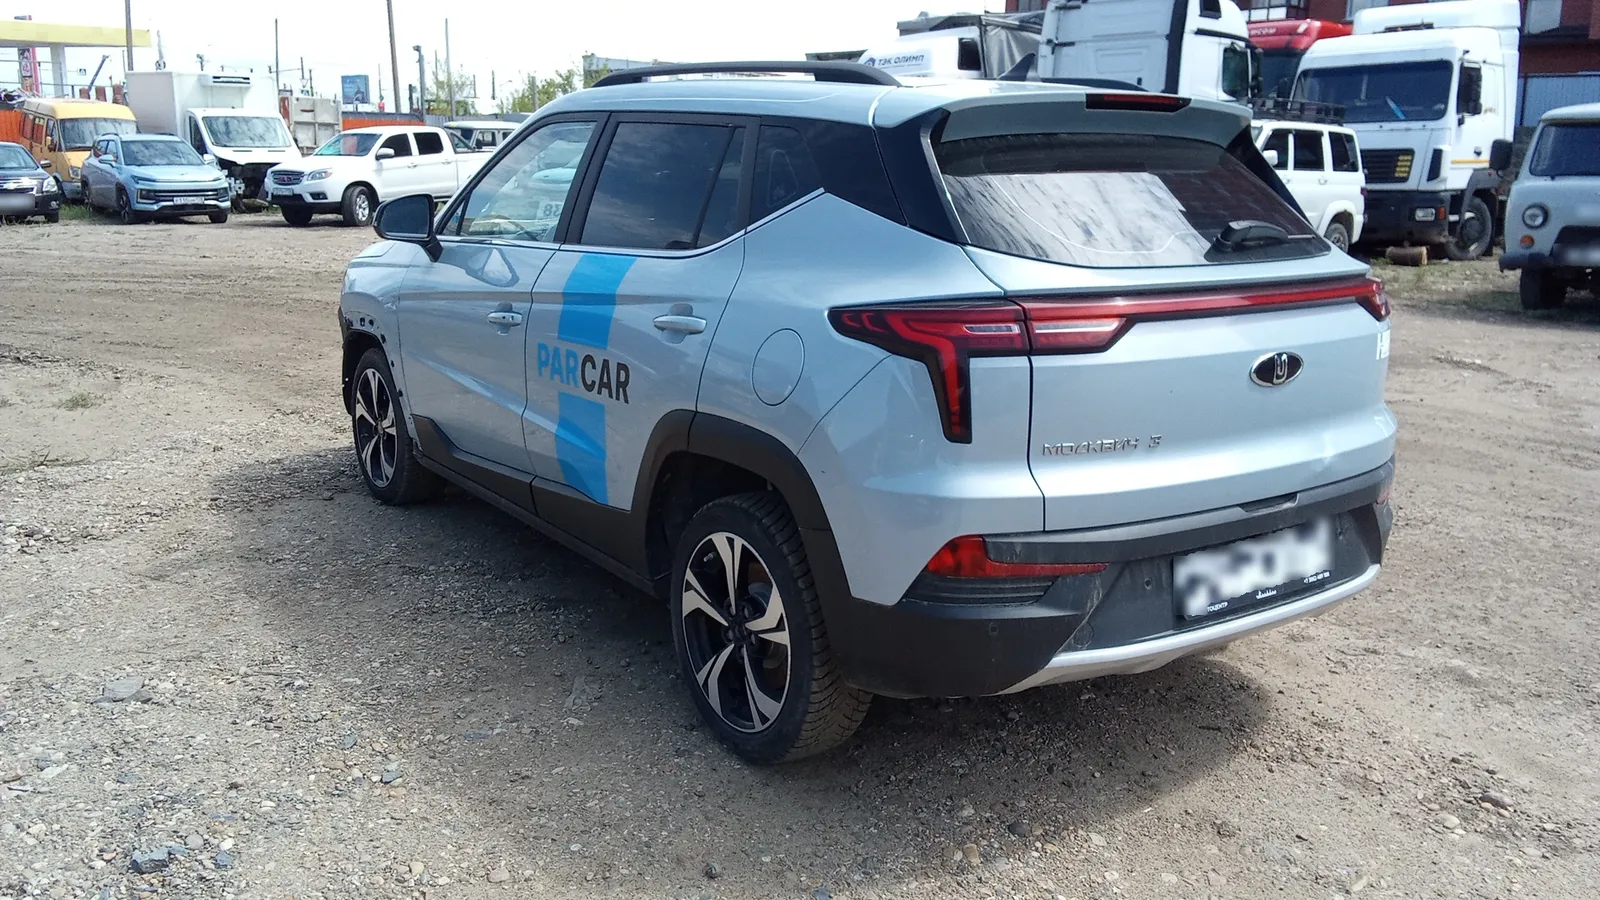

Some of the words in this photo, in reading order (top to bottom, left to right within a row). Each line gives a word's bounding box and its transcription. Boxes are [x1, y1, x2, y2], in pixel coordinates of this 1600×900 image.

[878, 57, 893, 66] ТЭК
[894, 54, 925, 64] ОЛИМП
[537, 341, 630, 405] PARCAR
[1148, 434, 1162, 448] 3
